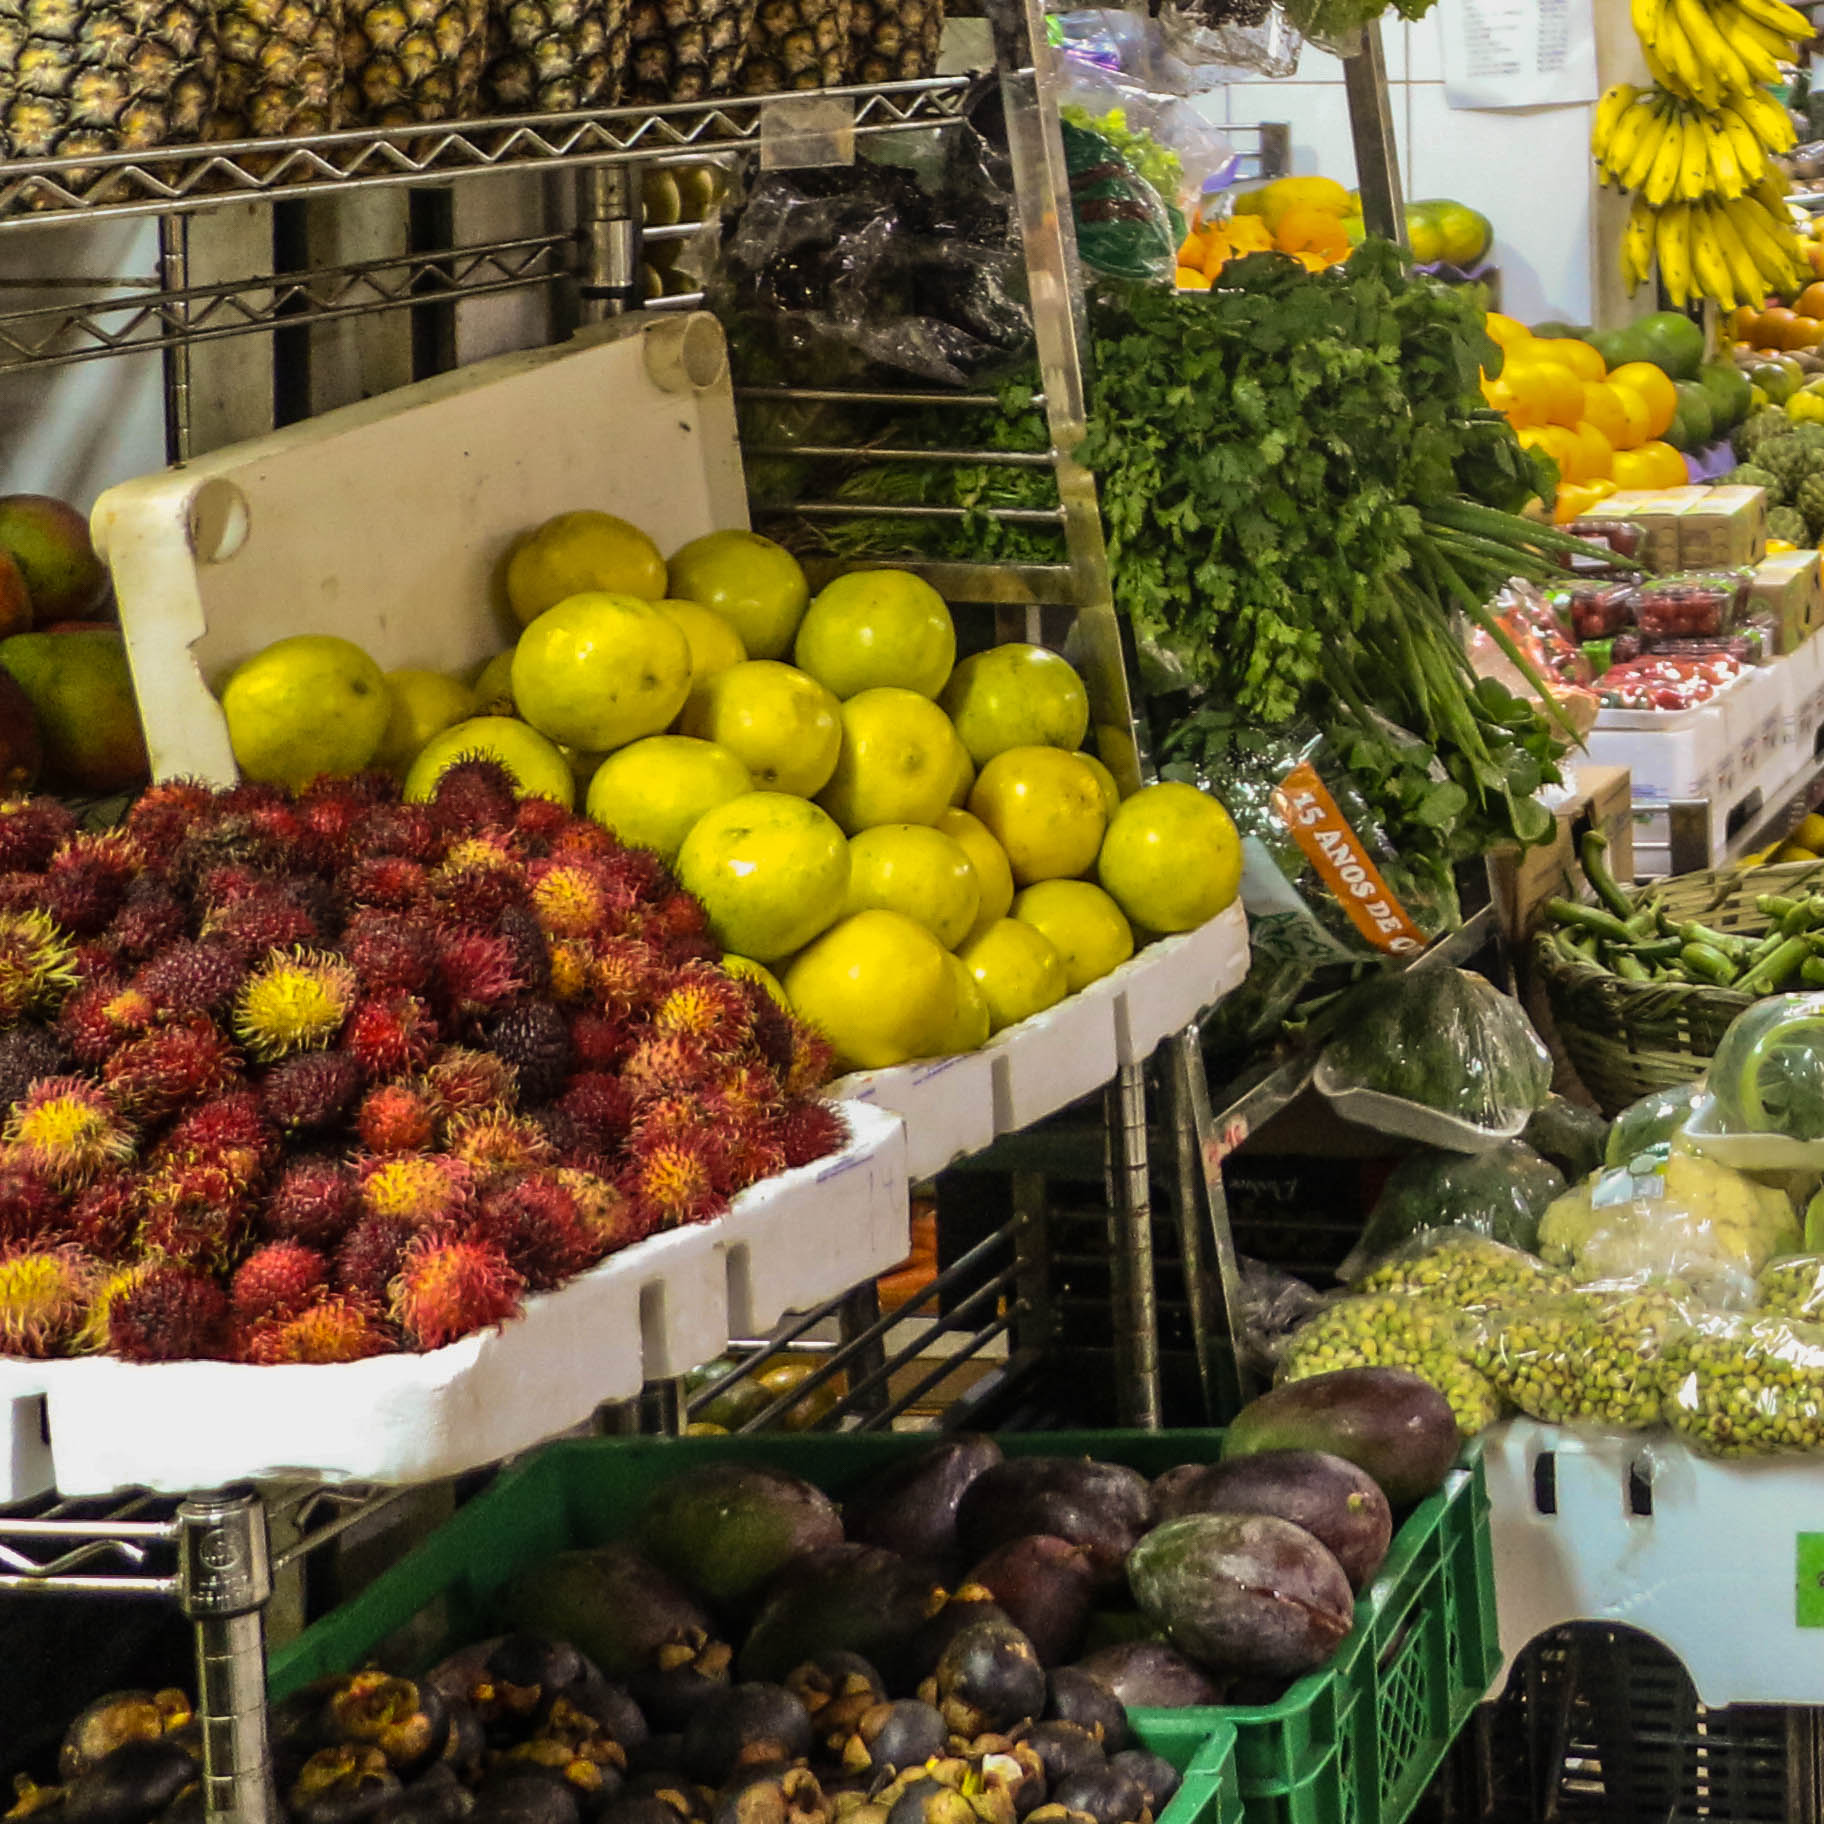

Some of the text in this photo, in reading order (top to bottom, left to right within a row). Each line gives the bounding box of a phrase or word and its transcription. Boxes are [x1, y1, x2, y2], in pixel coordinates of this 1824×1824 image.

[1292, 791, 1328, 826] 15
[1313, 829, 1377, 899] ANOS
[1365, 899, 1404, 934] DE
